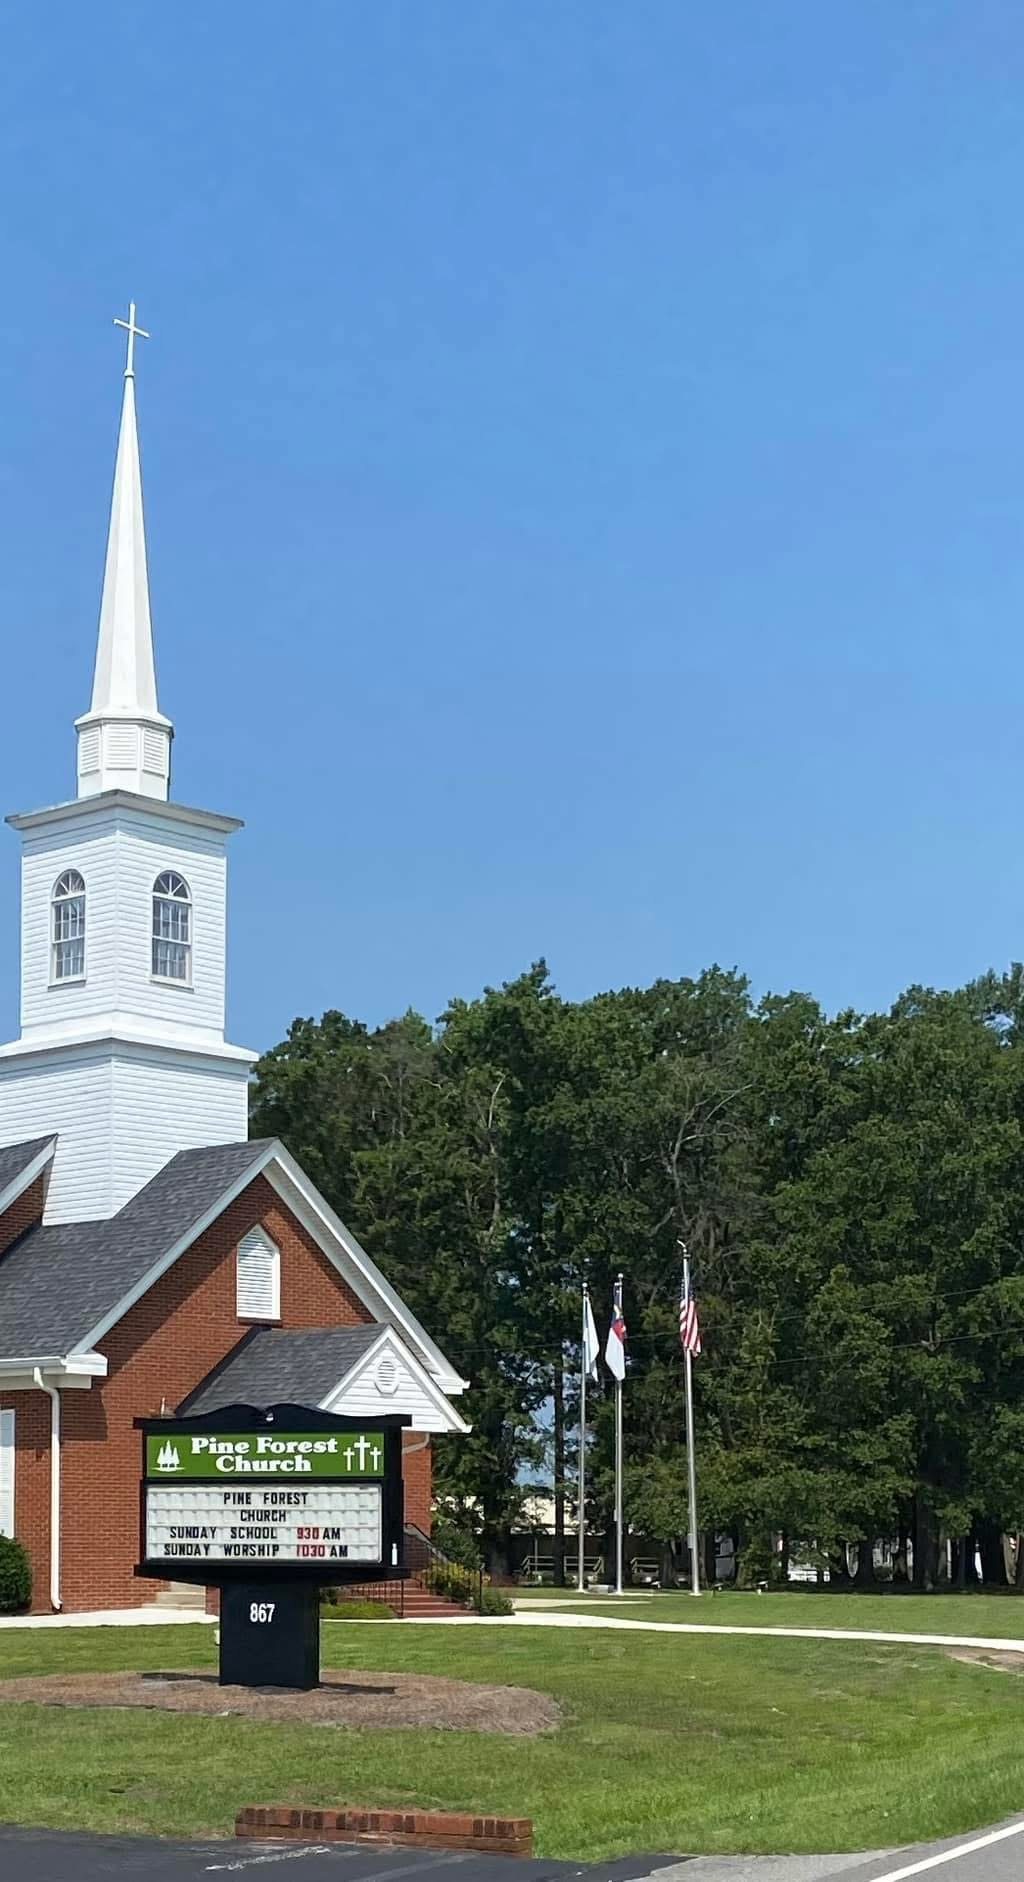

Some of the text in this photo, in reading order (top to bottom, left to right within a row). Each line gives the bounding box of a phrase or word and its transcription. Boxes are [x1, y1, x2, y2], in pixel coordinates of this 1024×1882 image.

[191, 1437, 338, 1455] Pine Forest
[215, 1454, 312, 1472] Church
[223, 1492, 309, 1505] PINE FOREST
[240, 1510, 287, 1522] CHURCH
[169, 1526, 341, 1539] SUNDAY SCHOOL 930 AM
[163, 1544, 348, 1557] SUNDAY WORSHIP 1030 AM
[249, 1603, 275, 1623] 867
